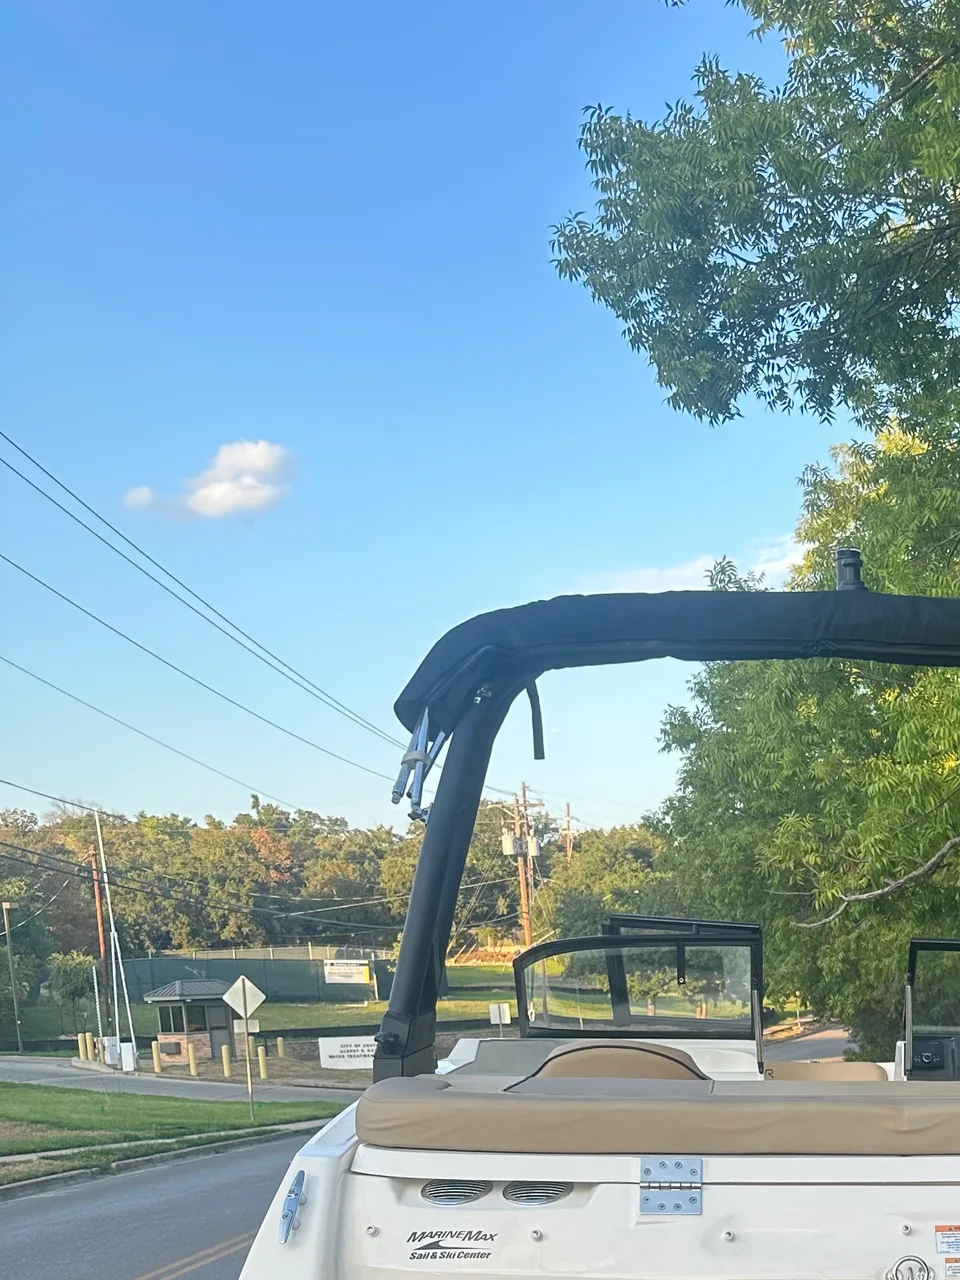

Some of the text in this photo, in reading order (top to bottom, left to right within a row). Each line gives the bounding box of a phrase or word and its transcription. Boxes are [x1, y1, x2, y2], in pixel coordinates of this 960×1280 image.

[409, 1250, 491, 1260] Sail & Ski Center
